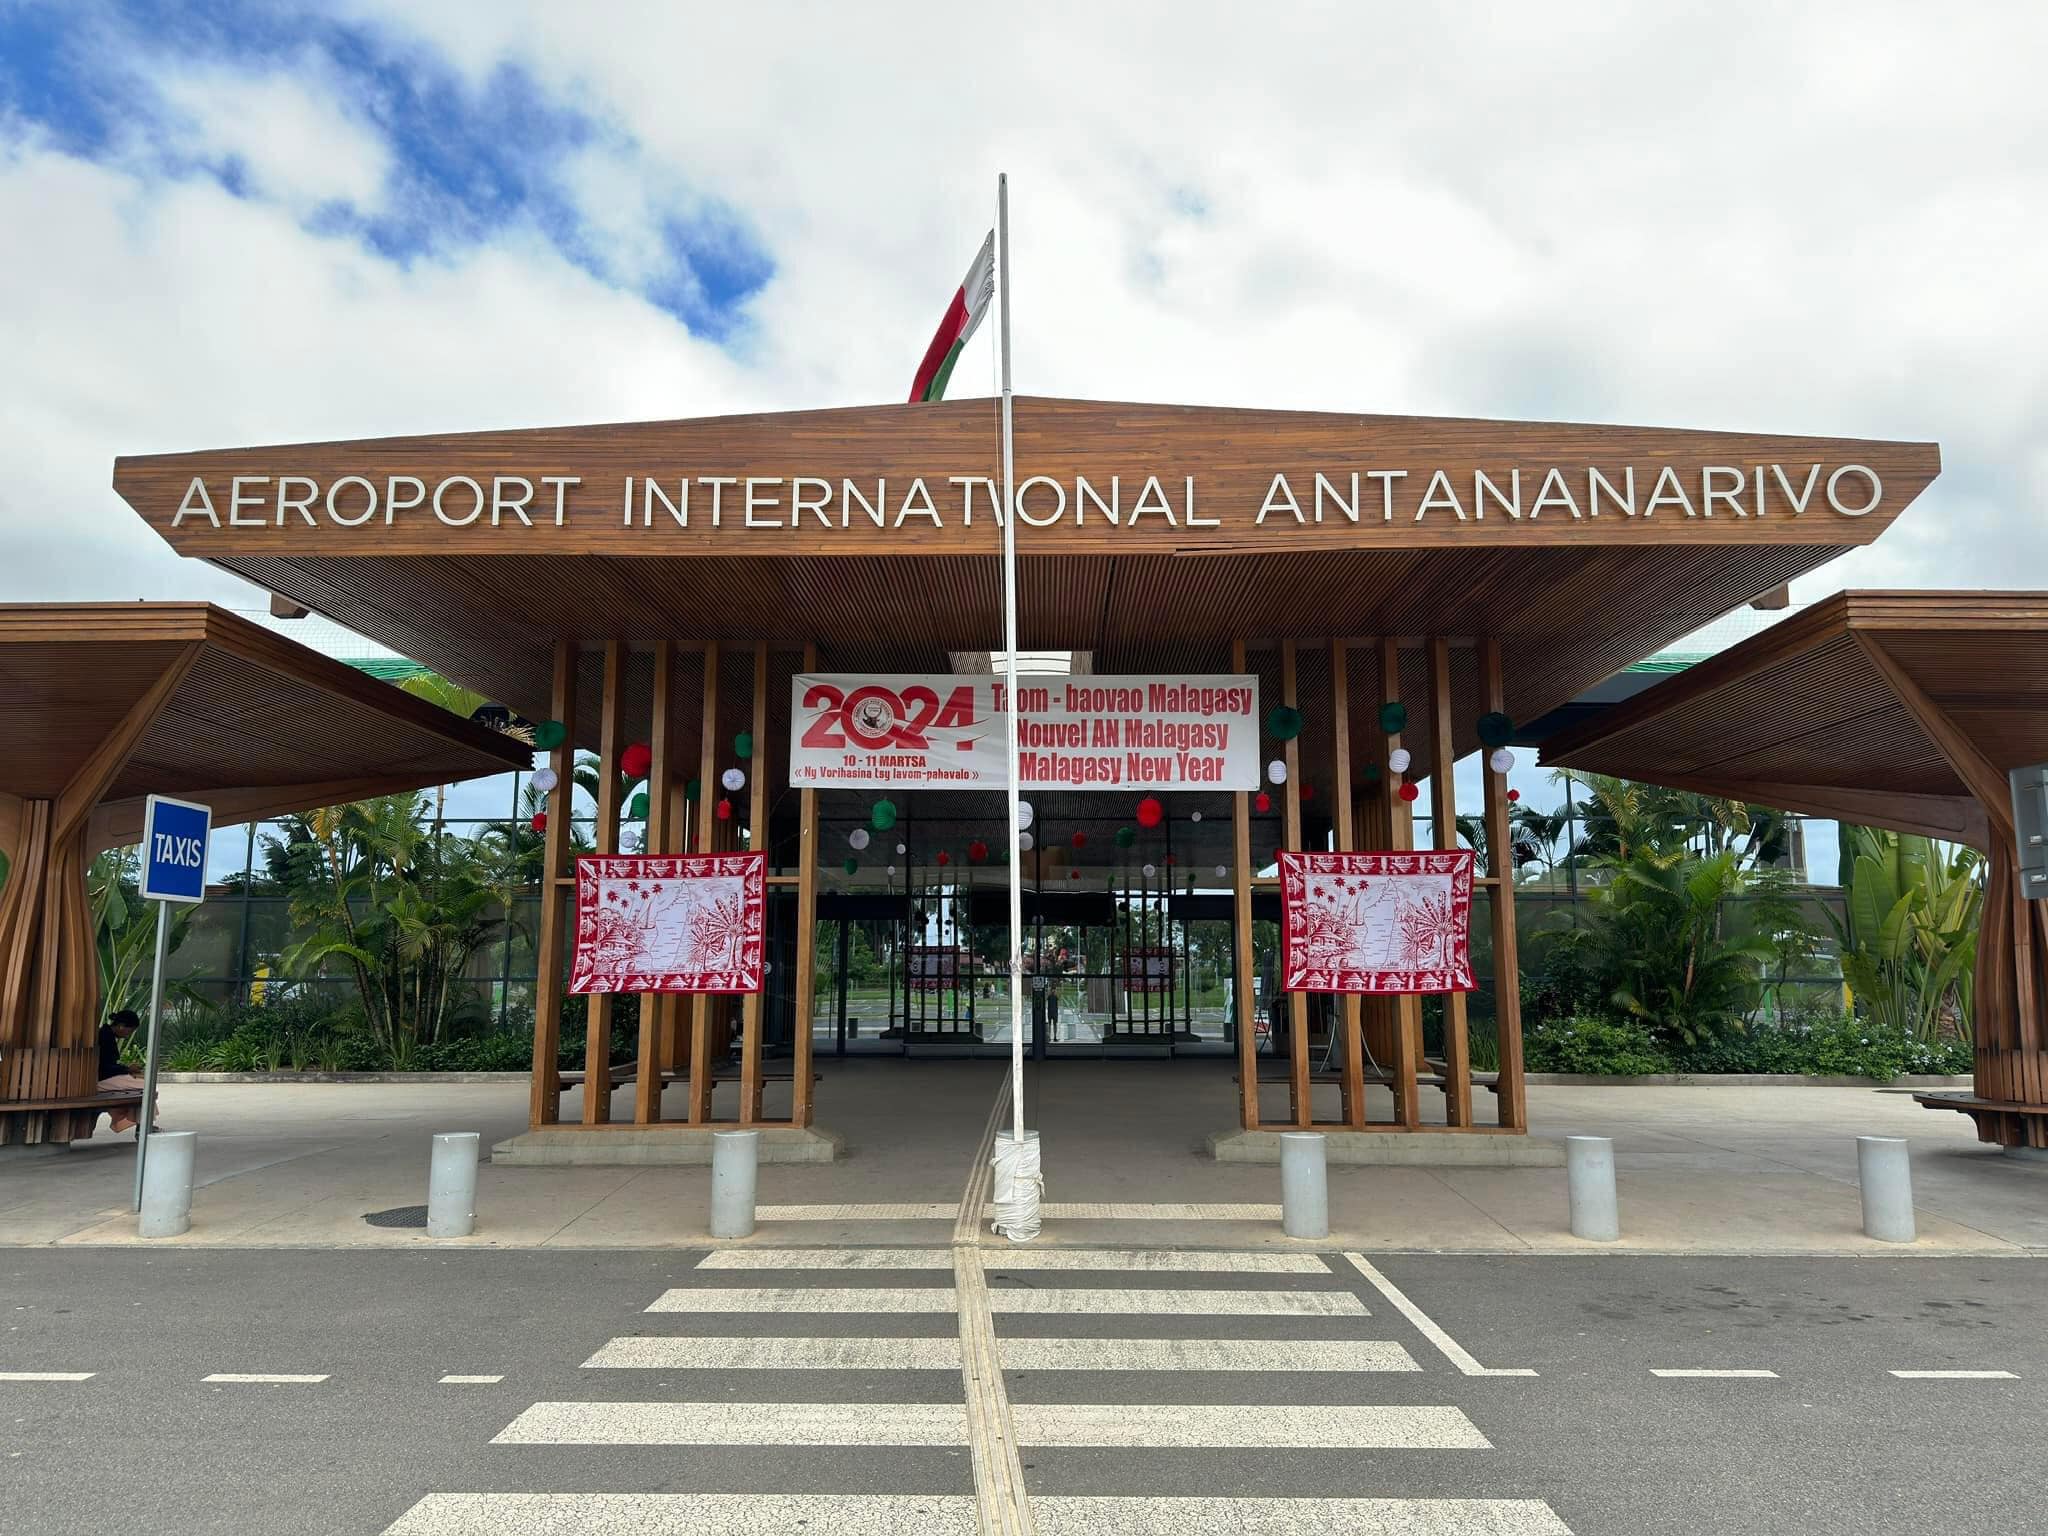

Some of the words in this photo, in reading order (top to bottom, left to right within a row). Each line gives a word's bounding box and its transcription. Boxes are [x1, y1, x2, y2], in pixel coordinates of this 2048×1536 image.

[171, 476, 581, 528] AEROPORT
[624, 476, 1220, 527] INTERNATIONAL
[1256, 464, 1882, 524] ANTANANARIVO
[1066, 684, 1143, 713] baovao
[1149, 684, 1252, 715] Malagasy
[801, 684, 976, 751] 2024
[1017, 719, 1088, 748] Nouvel
[1092, 719, 1119, 747] AN
[1125, 719, 1229, 751] Malagasy
[820, 766, 872, 778] Vorihasina
[843, 755, 856, 767] 10
[865, 755, 876, 767] 11
[879, 755, 927, 767] MARTSA
[1019, 752, 1122, 784] Malagasy
[1127, 753, 1172, 781] New
[1176, 753, 1225, 781] Year
[155, 833, 201, 868] TAXIS
